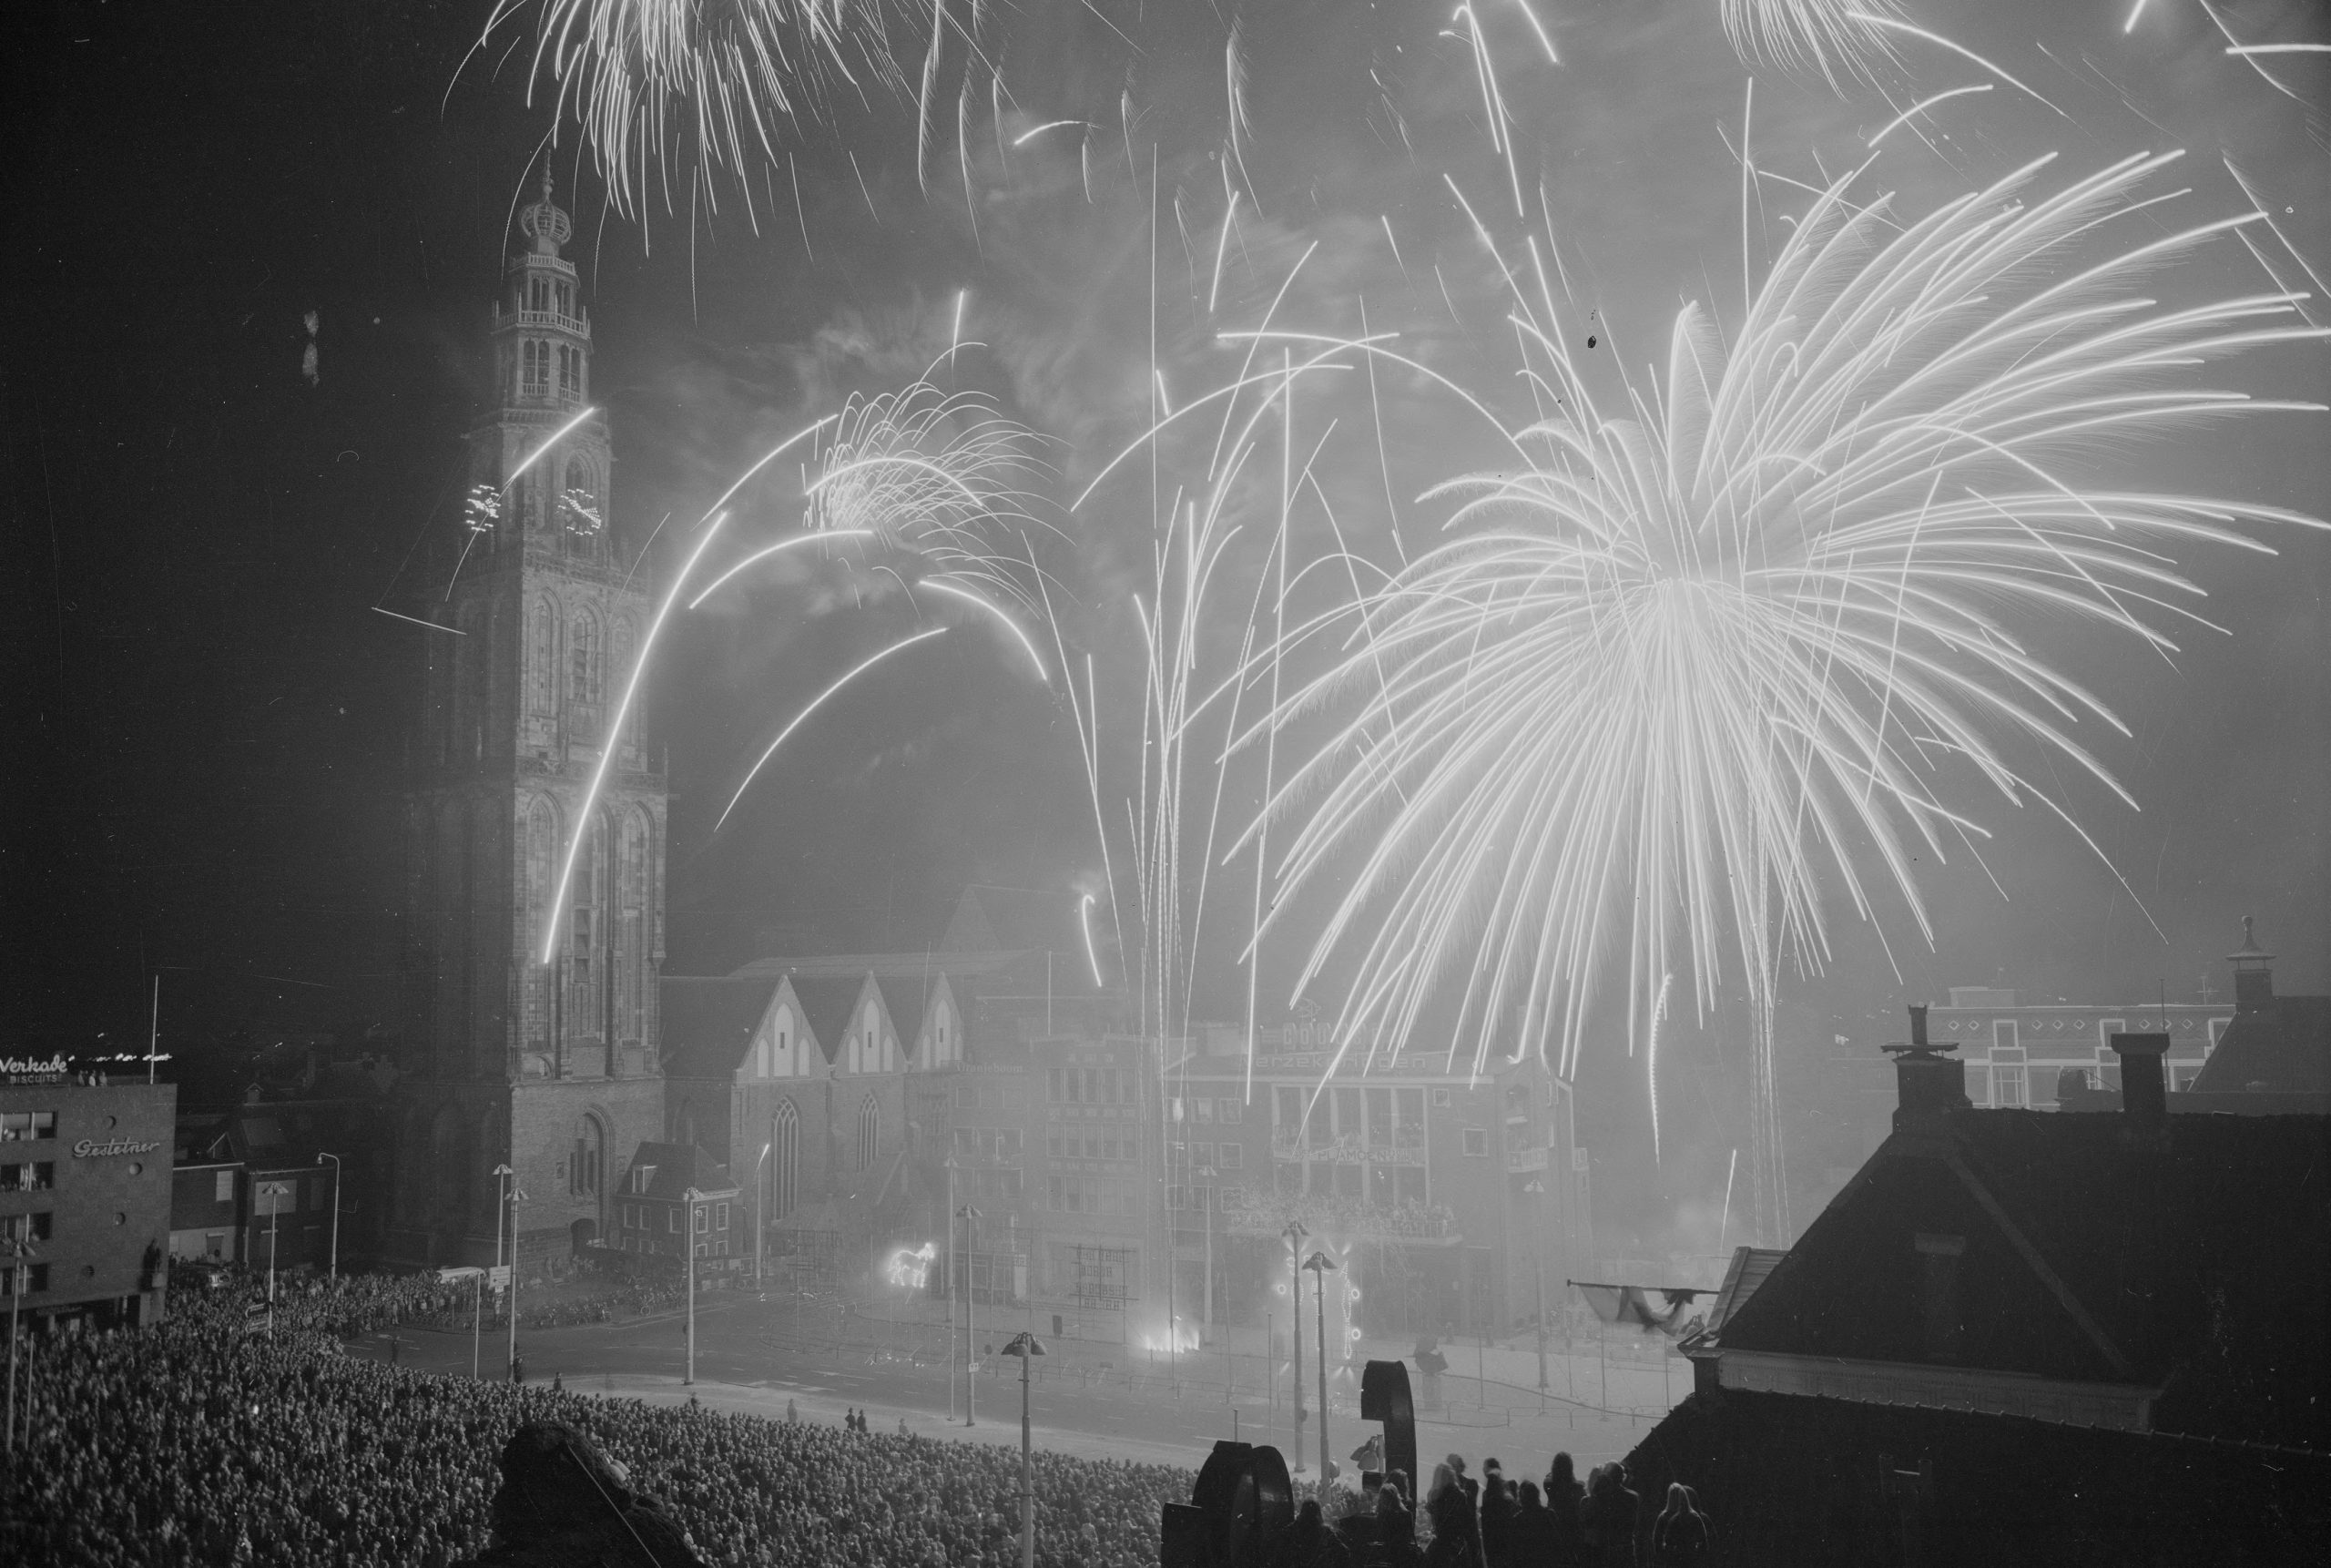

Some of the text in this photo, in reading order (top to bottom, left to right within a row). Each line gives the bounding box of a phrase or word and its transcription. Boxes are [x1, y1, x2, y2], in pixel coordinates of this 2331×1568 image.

[0, 1054, 68, 1074] Verkade
[956, 1062, 1023, 1074] Oranjeboom
[9, 1074, 58, 1084] BISCUITS
[74, 1136, 160, 1157] Gestetner
